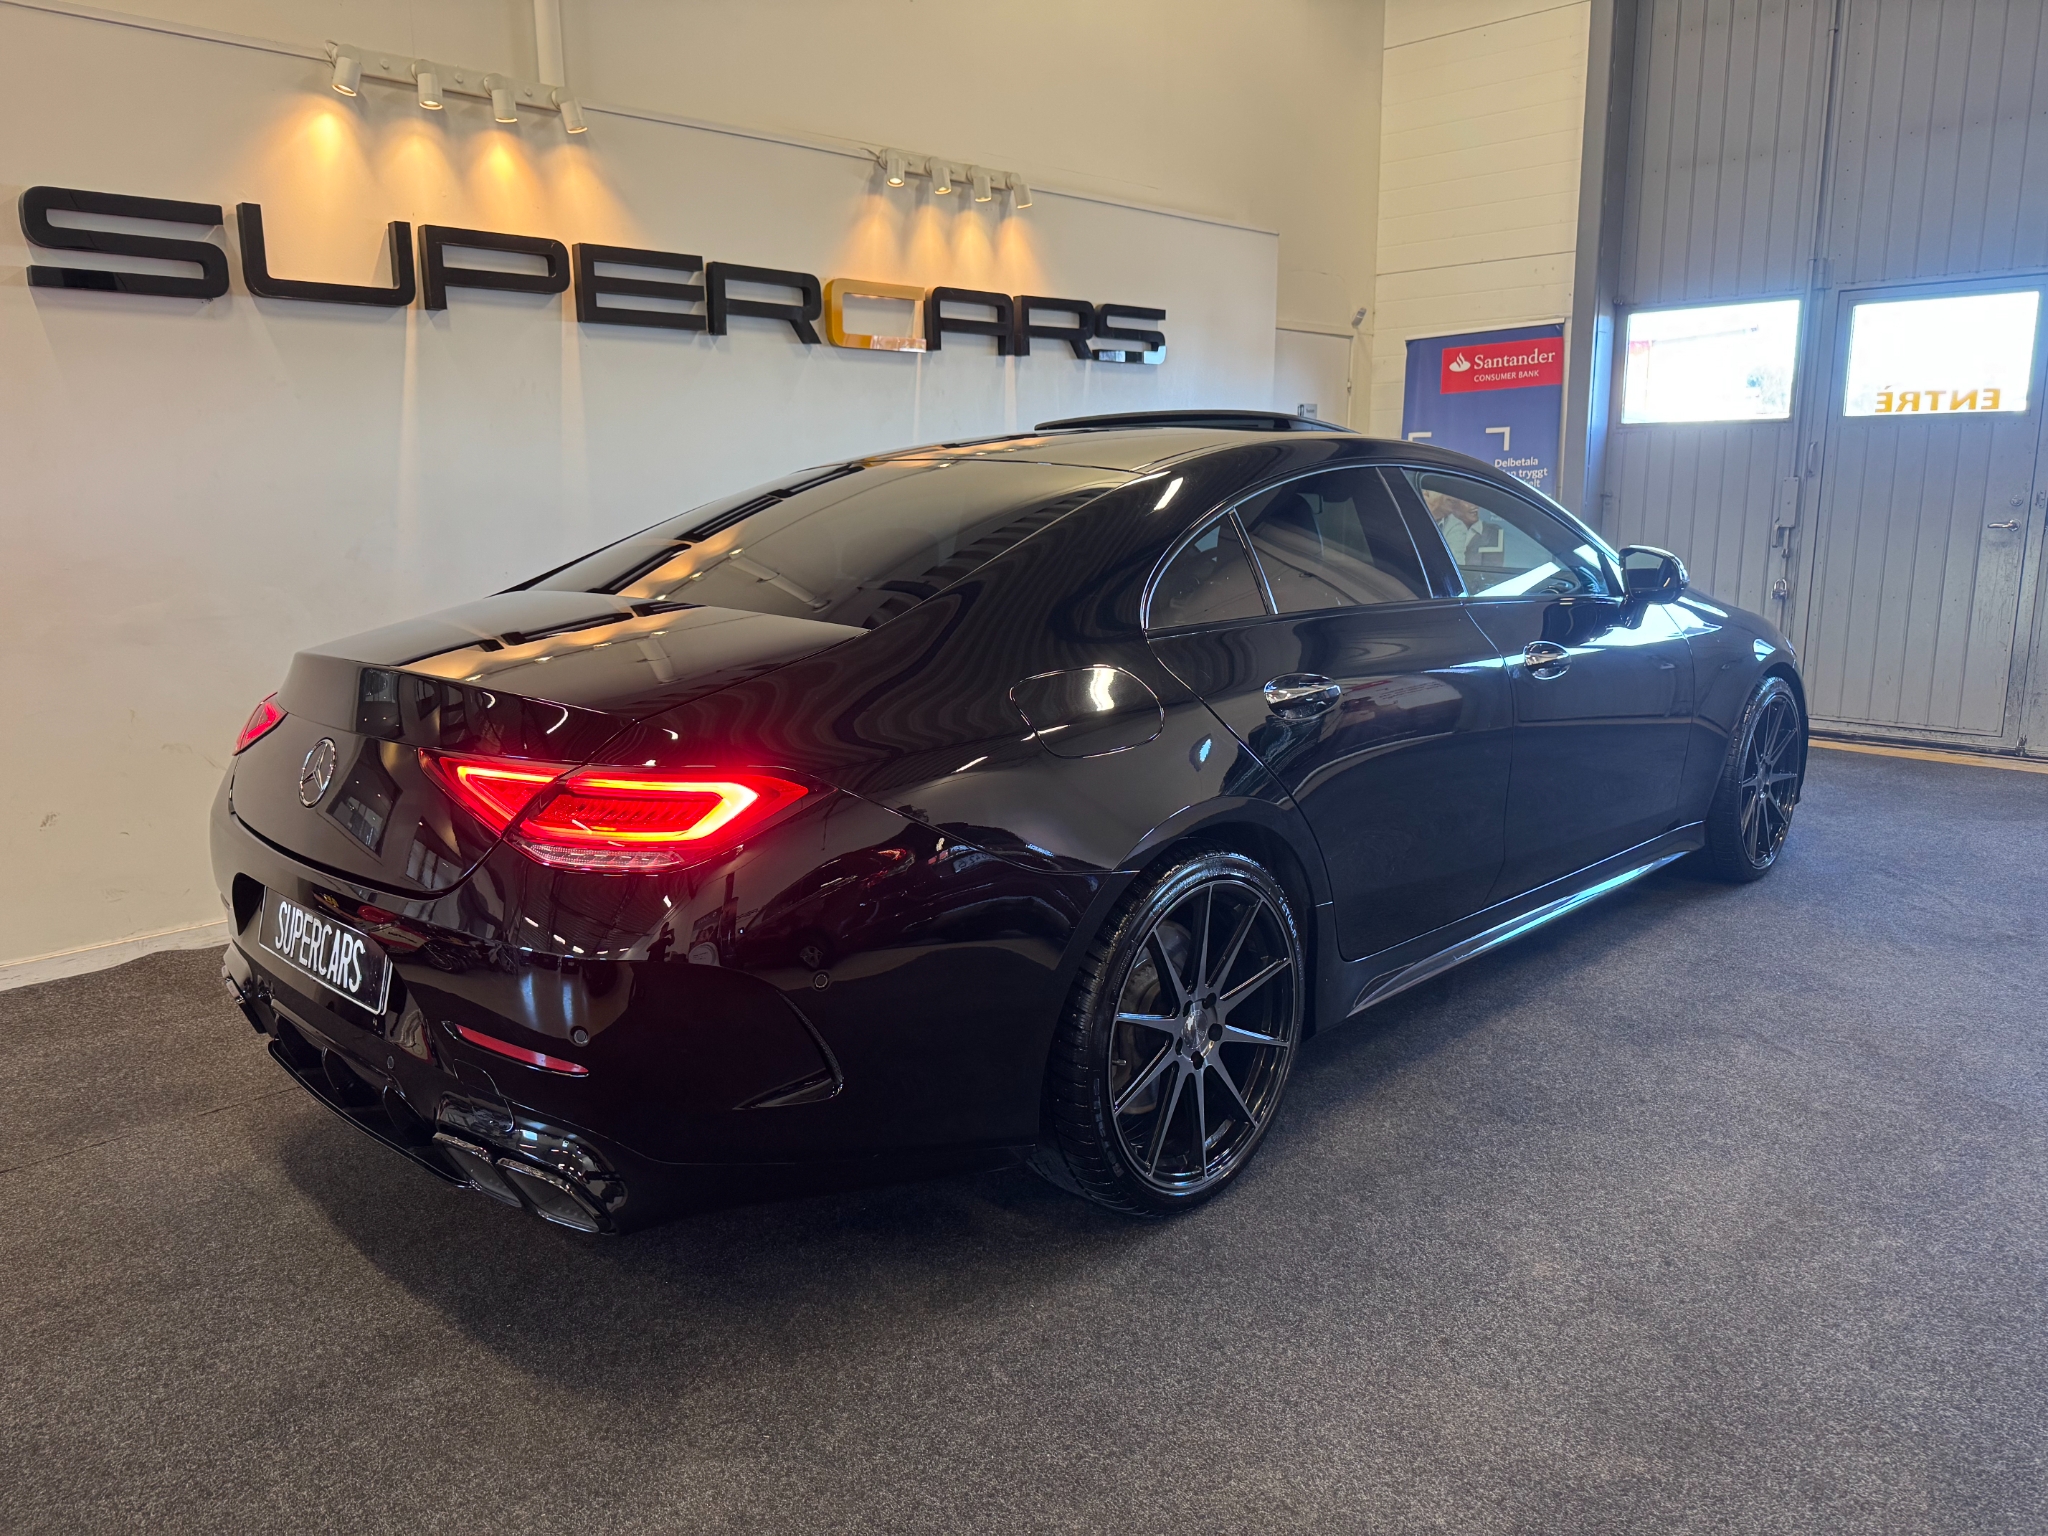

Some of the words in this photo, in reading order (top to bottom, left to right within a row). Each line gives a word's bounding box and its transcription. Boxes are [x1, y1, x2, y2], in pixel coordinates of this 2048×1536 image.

[18, 185, 1167, 366] SUPERCARS
[1473, 348, 1556, 370] Santander
[1473, 371, 1517, 383] CONSUMER
[1518, 370, 1540, 379] BANK
[1494, 456, 1539, 468] Delbetala
[1518, 467, 1548, 480] tryggt
[275, 901, 366, 993] SUPERCARS
